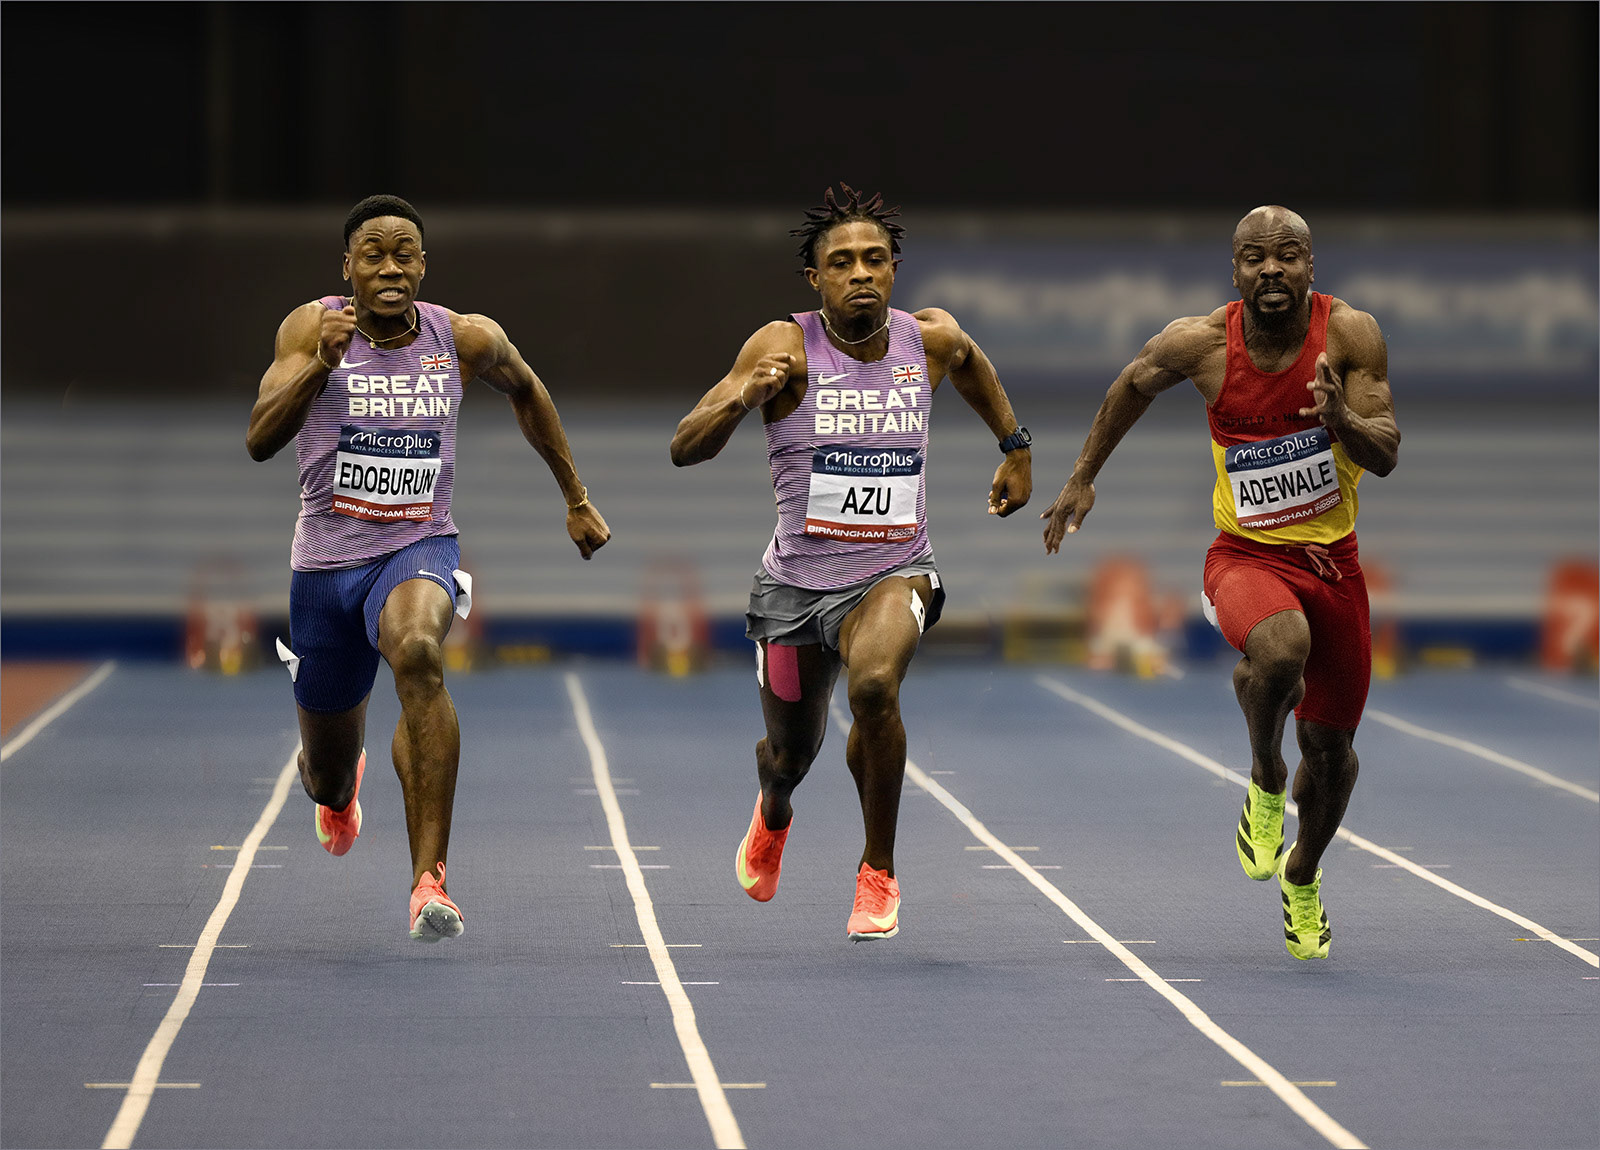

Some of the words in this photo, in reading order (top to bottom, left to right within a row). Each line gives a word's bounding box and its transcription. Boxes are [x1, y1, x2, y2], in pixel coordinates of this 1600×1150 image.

[347, 374, 450, 395] GREAT
[348, 397, 451, 417] BRITAIN
[815, 386, 922, 411] GREAT
[814, 411, 923, 434] BRITAIN
[368, 447, 406, 455] PROCESSING
[1253, 454, 1289, 466] PROCESSING
[1297, 446, 1319, 456] TIMING
[339, 462, 436, 496] EDOBURUN
[1240, 460, 1333, 507] ADEWALE
[334, 501, 404, 518] BIRMINGHAM
[840, 487, 891, 516] AZU
[1314, 495, 1341, 511] INDOOR
[807, 525, 885, 538] BIRMINGHAM
